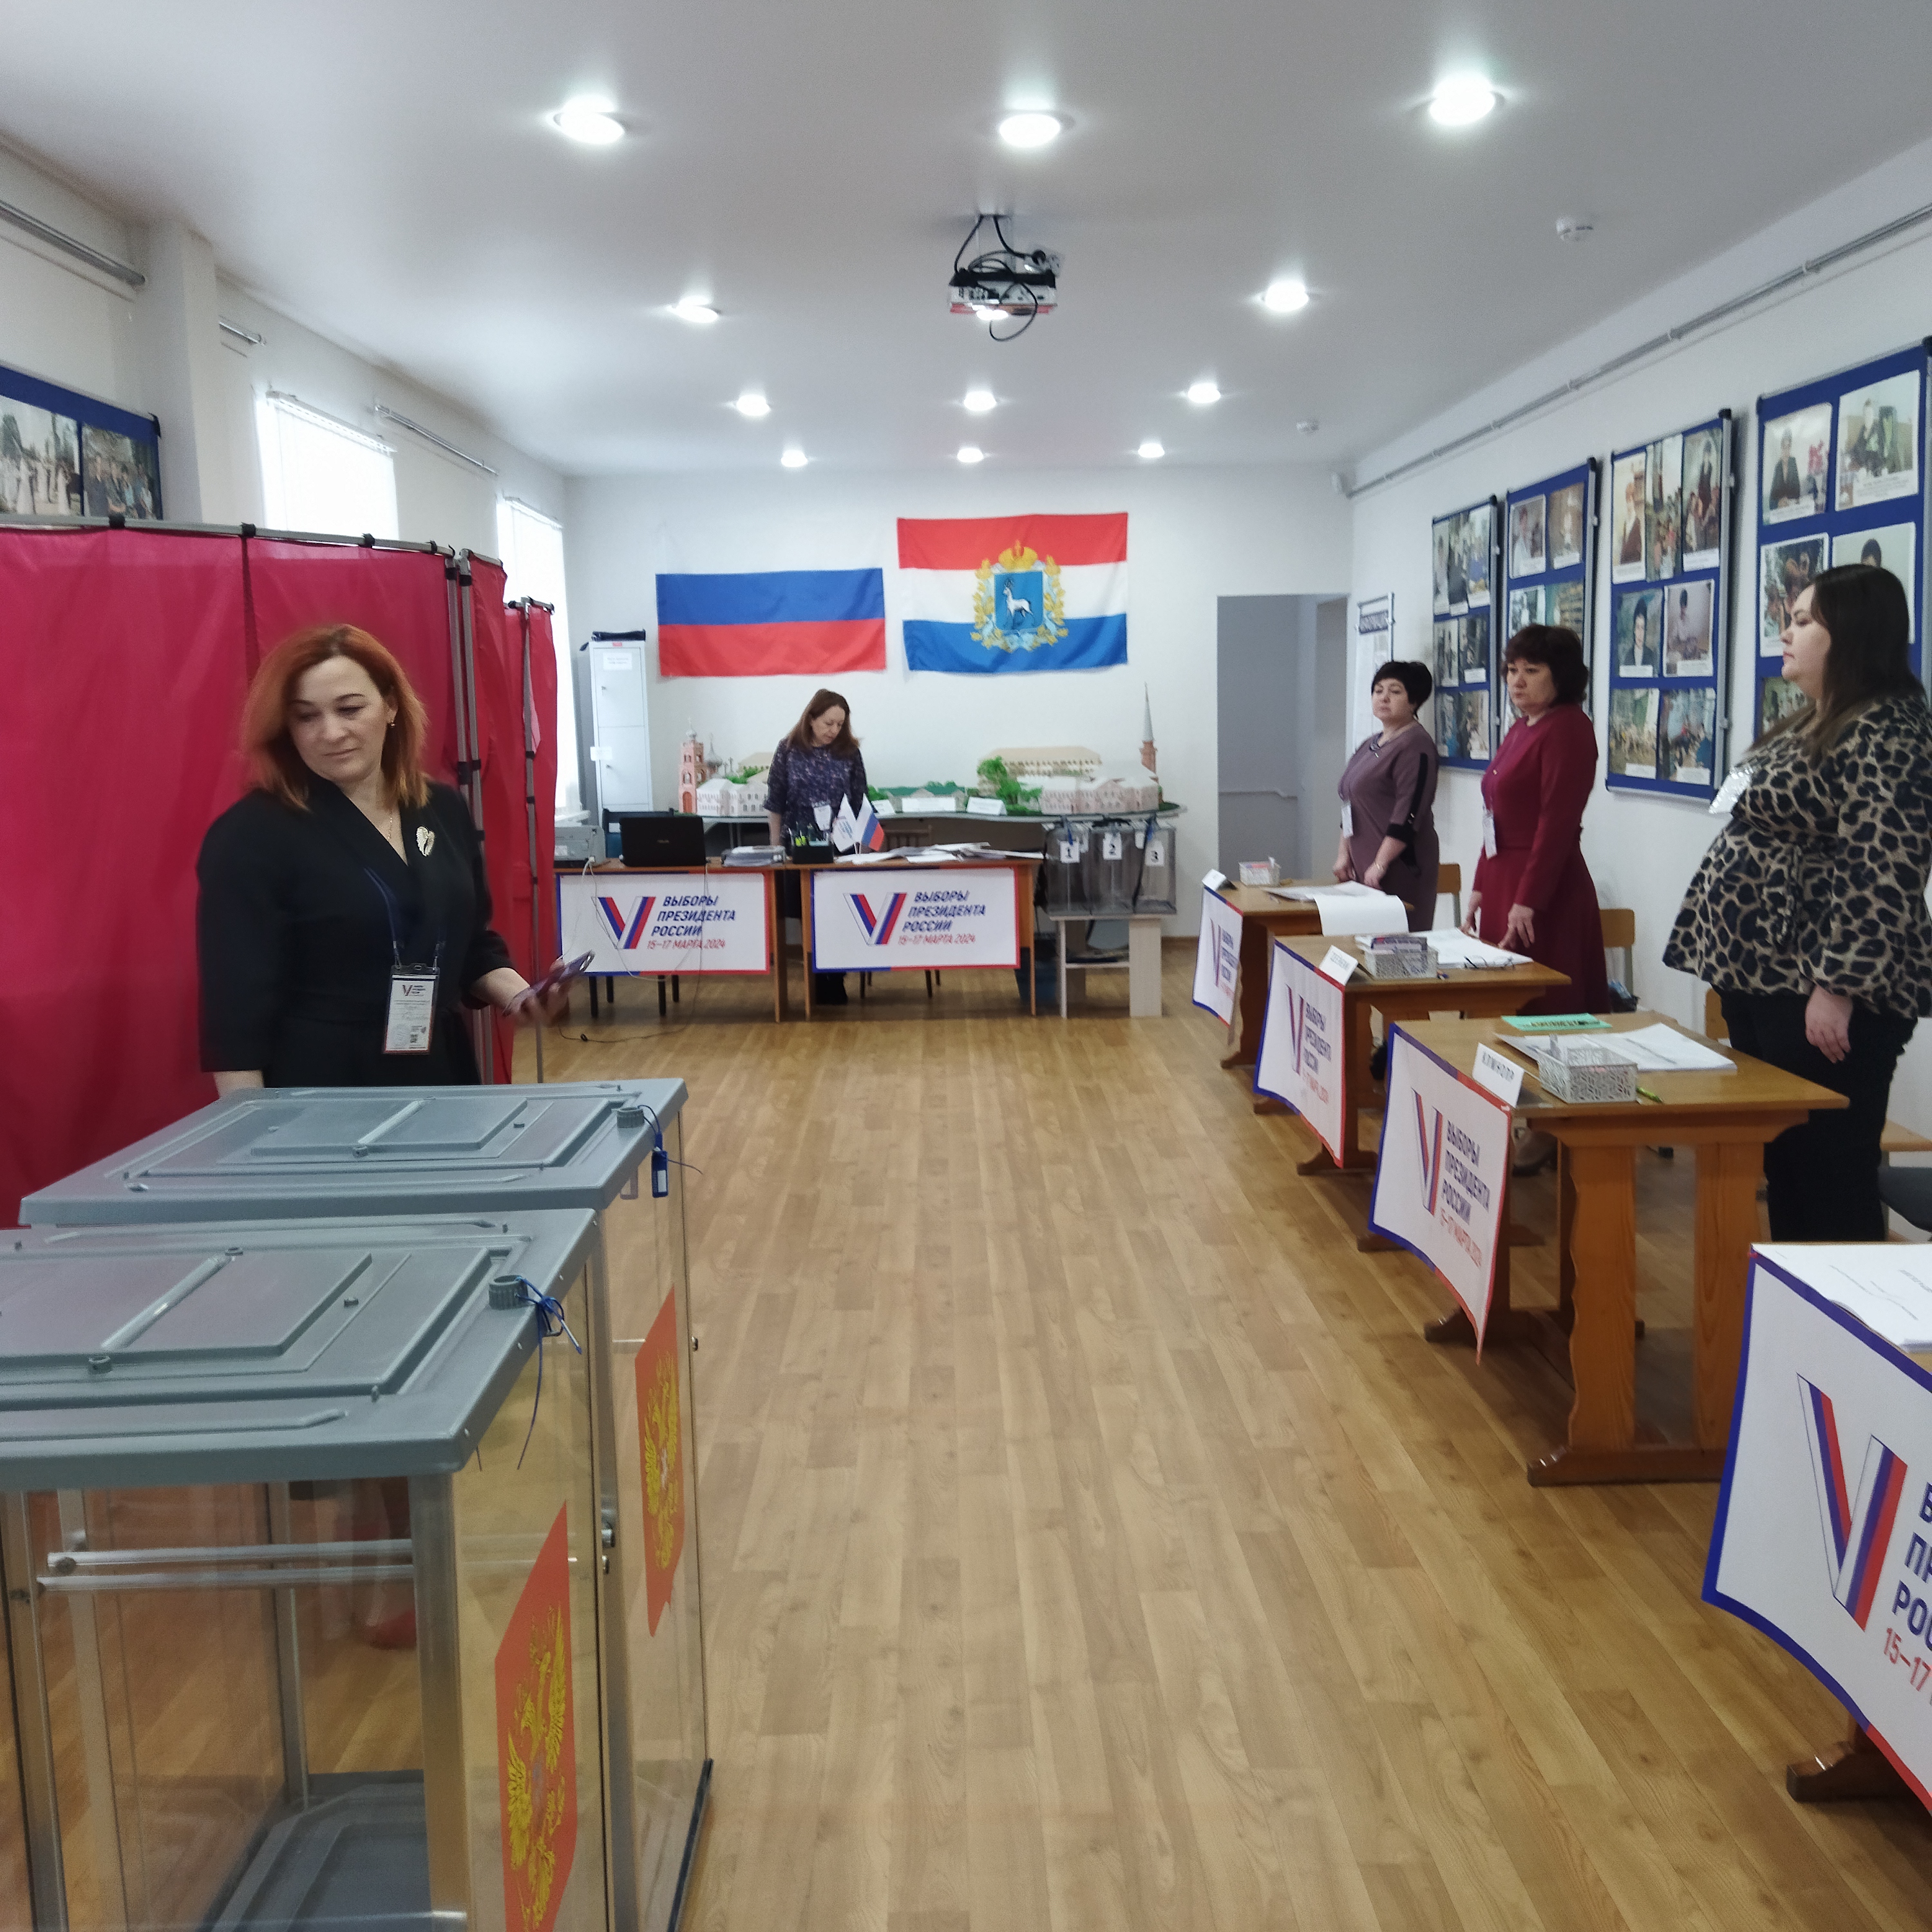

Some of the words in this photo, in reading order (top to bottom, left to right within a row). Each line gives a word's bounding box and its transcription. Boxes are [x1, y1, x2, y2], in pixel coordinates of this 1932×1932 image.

[1108, 843, 1116, 855] 2
[662, 895, 719, 907] ВЫБОРЫ
[914, 890, 970, 902] ВЫБОРЫ
[657, 909, 735, 922] ПРЕЗИДЕНТА
[908, 905, 986, 918] ПРЕЗИДЕНТА
[650, 925, 703, 936] РОССИИ
[902, 920, 952, 932] РОССИИ
[704, 939, 726, 949] 2024
[1446, 1119, 1481, 1168] ВЫБОРЫ
